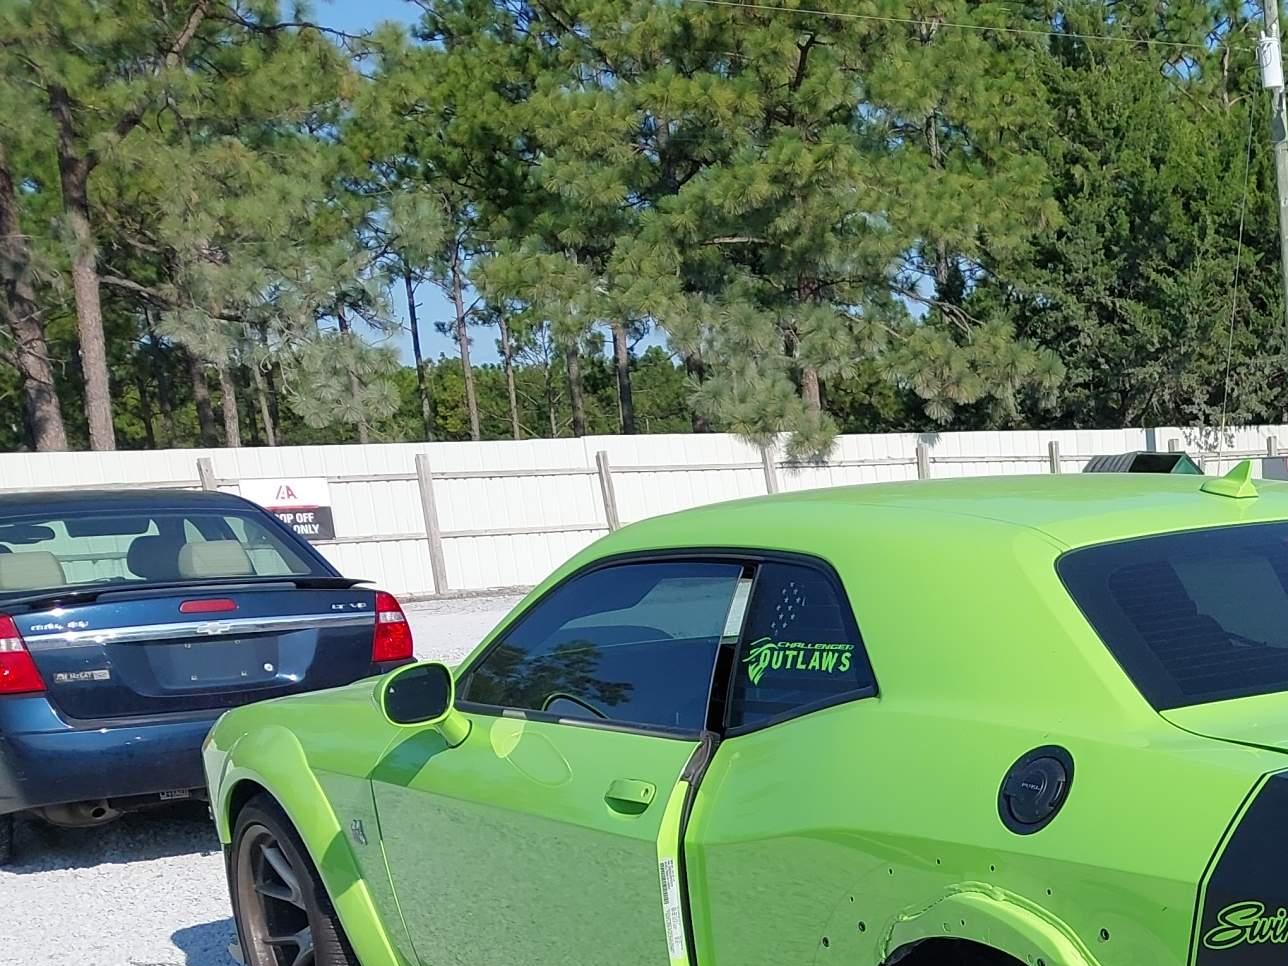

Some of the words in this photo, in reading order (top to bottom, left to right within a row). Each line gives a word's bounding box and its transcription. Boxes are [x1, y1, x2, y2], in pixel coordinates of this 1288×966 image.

[295, 512, 315, 523] OFF
[777, 641, 855, 650] CHALLENGER
[758, 649, 852, 674] OUTLAWS
